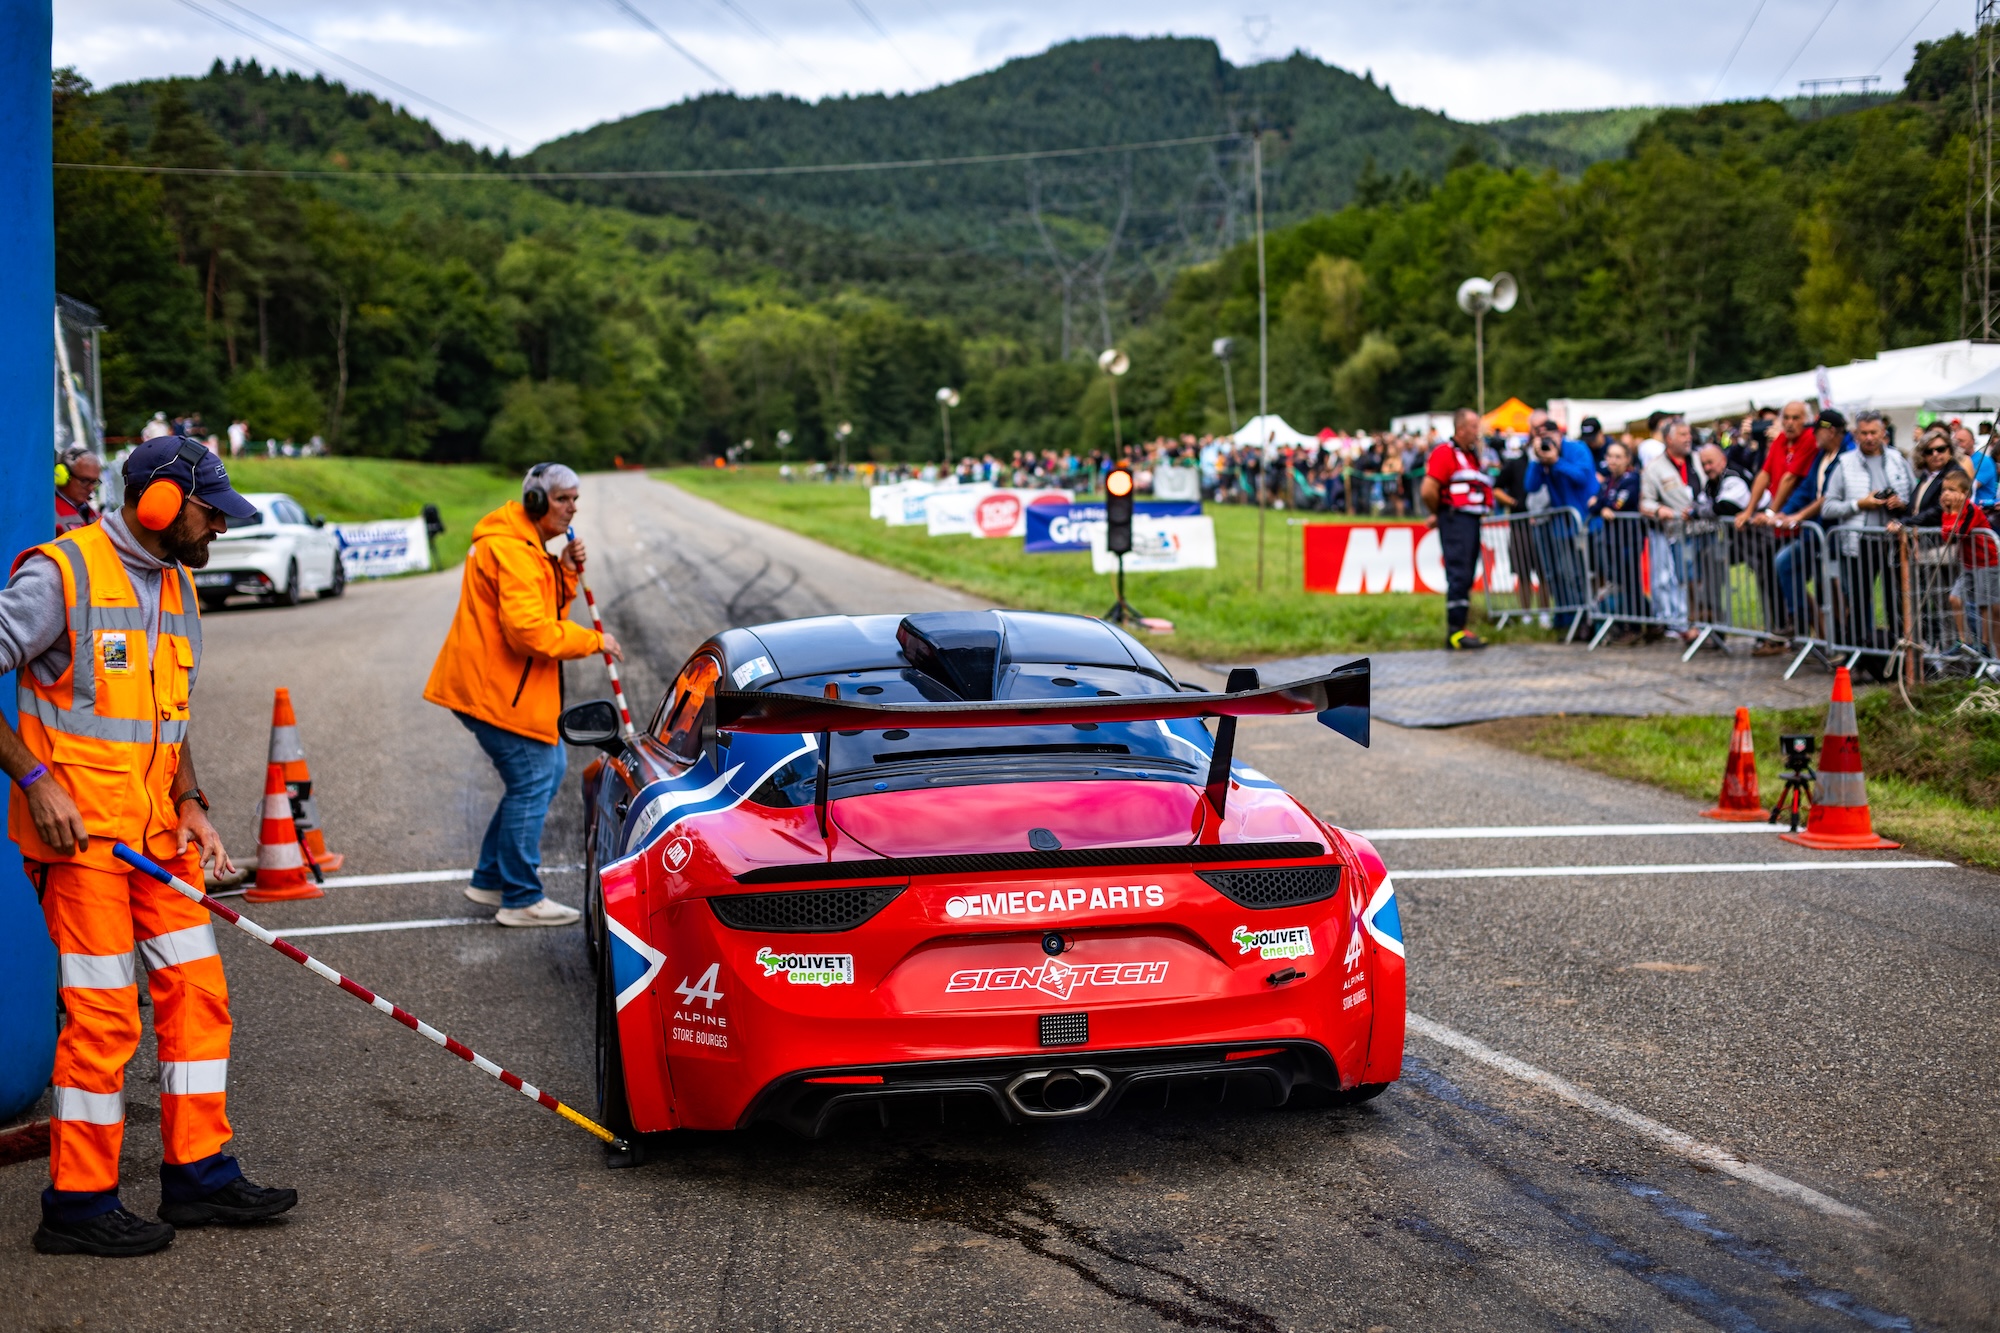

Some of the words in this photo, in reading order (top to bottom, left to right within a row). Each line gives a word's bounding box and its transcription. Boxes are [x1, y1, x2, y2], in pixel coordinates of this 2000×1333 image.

[982, 885, 1165, 916] MECAPARTS
[1252, 929, 1304, 946] JOLIVET
[1262, 942, 1305, 957] energie
[778, 957, 845, 969] JOLIVET
[790, 969, 843, 984] energie
[945, 965, 1046, 993] SIGN
[1068, 961, 1170, 987] TECH
[1343, 971, 1365, 990] ALPINE
[673, 1010, 727, 1028] ALPINE
[672, 1027, 694, 1043] STORE
[695, 1031, 728, 1048] BOURGES
